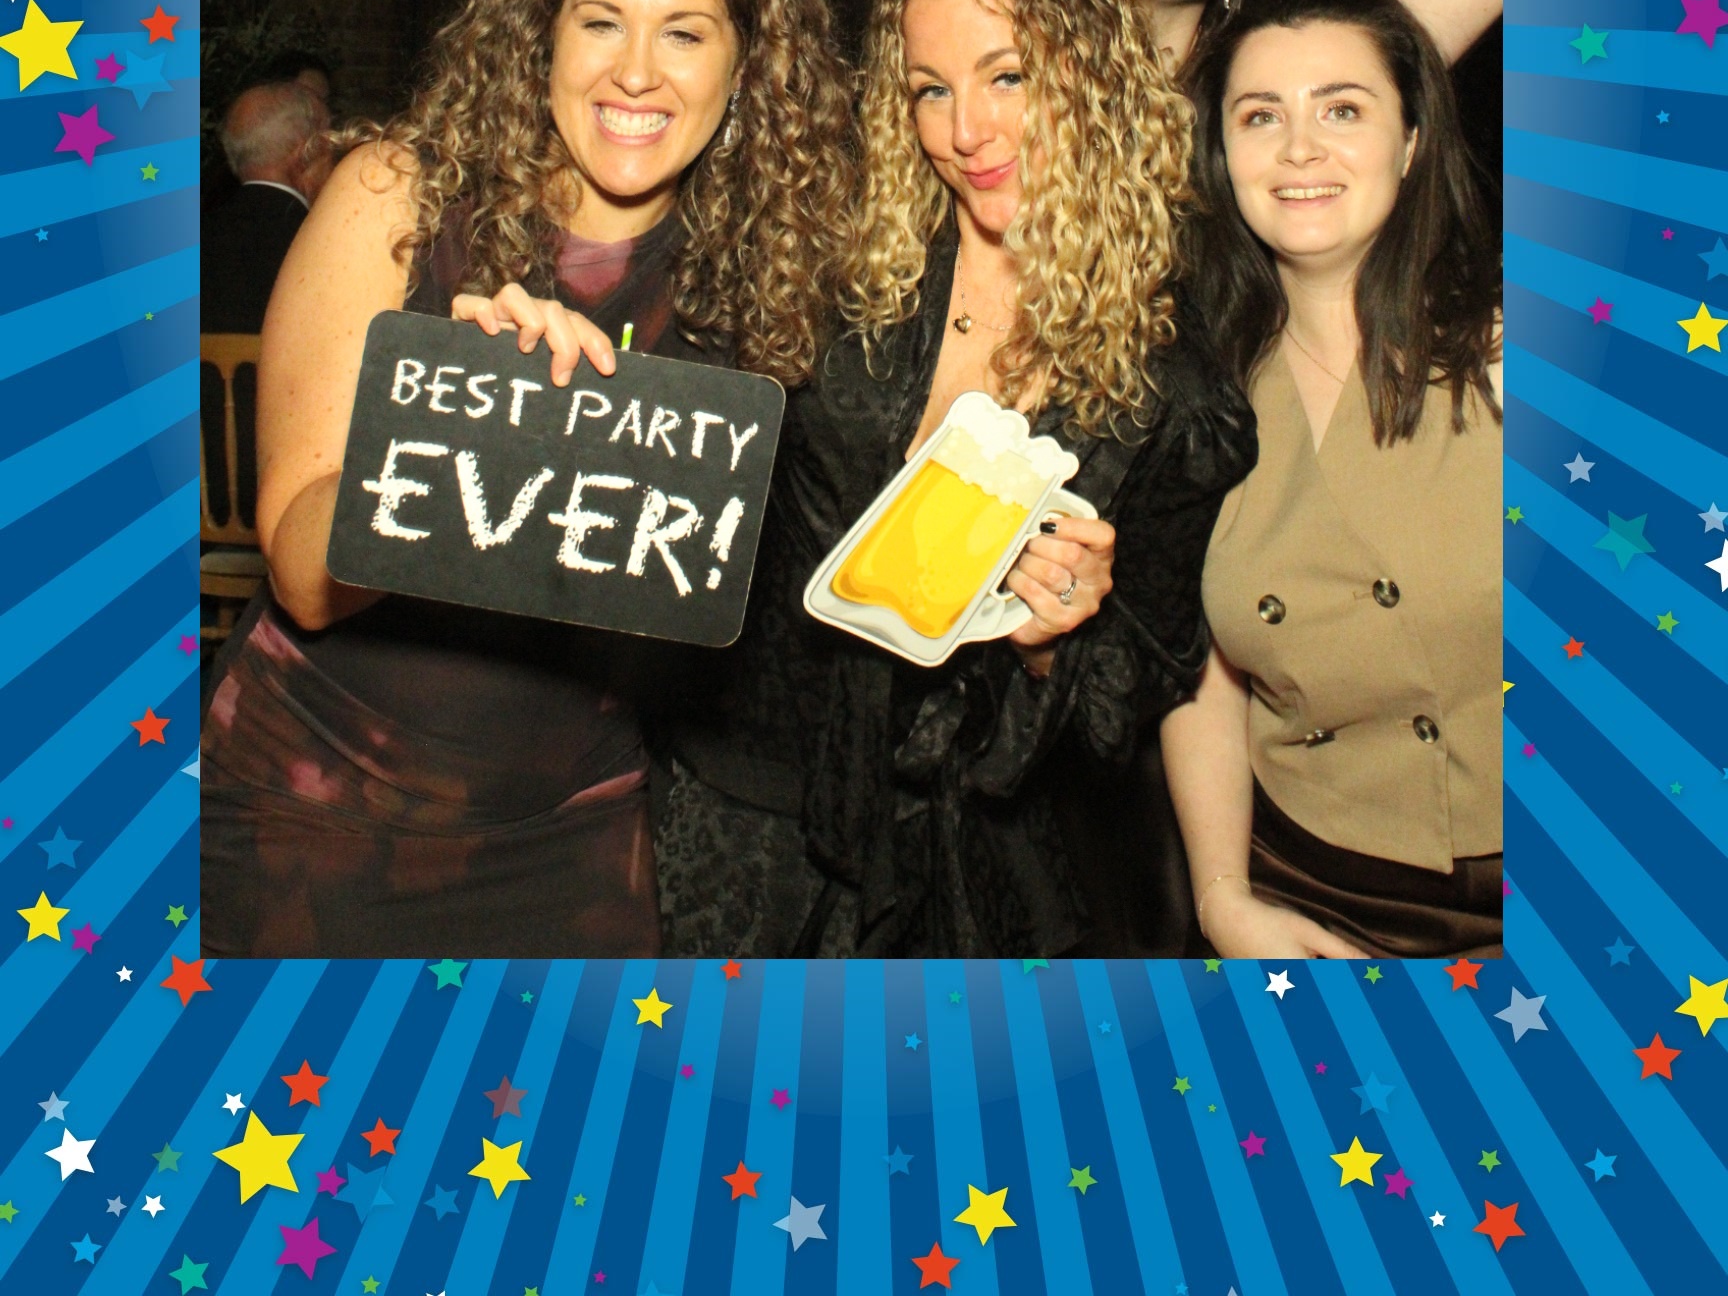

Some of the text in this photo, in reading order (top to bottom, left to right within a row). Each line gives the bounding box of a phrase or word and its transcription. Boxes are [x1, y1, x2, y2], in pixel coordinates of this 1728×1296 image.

[389, 358, 760, 472] BEST PARTY
[361, 437, 746, 598] EVER!
